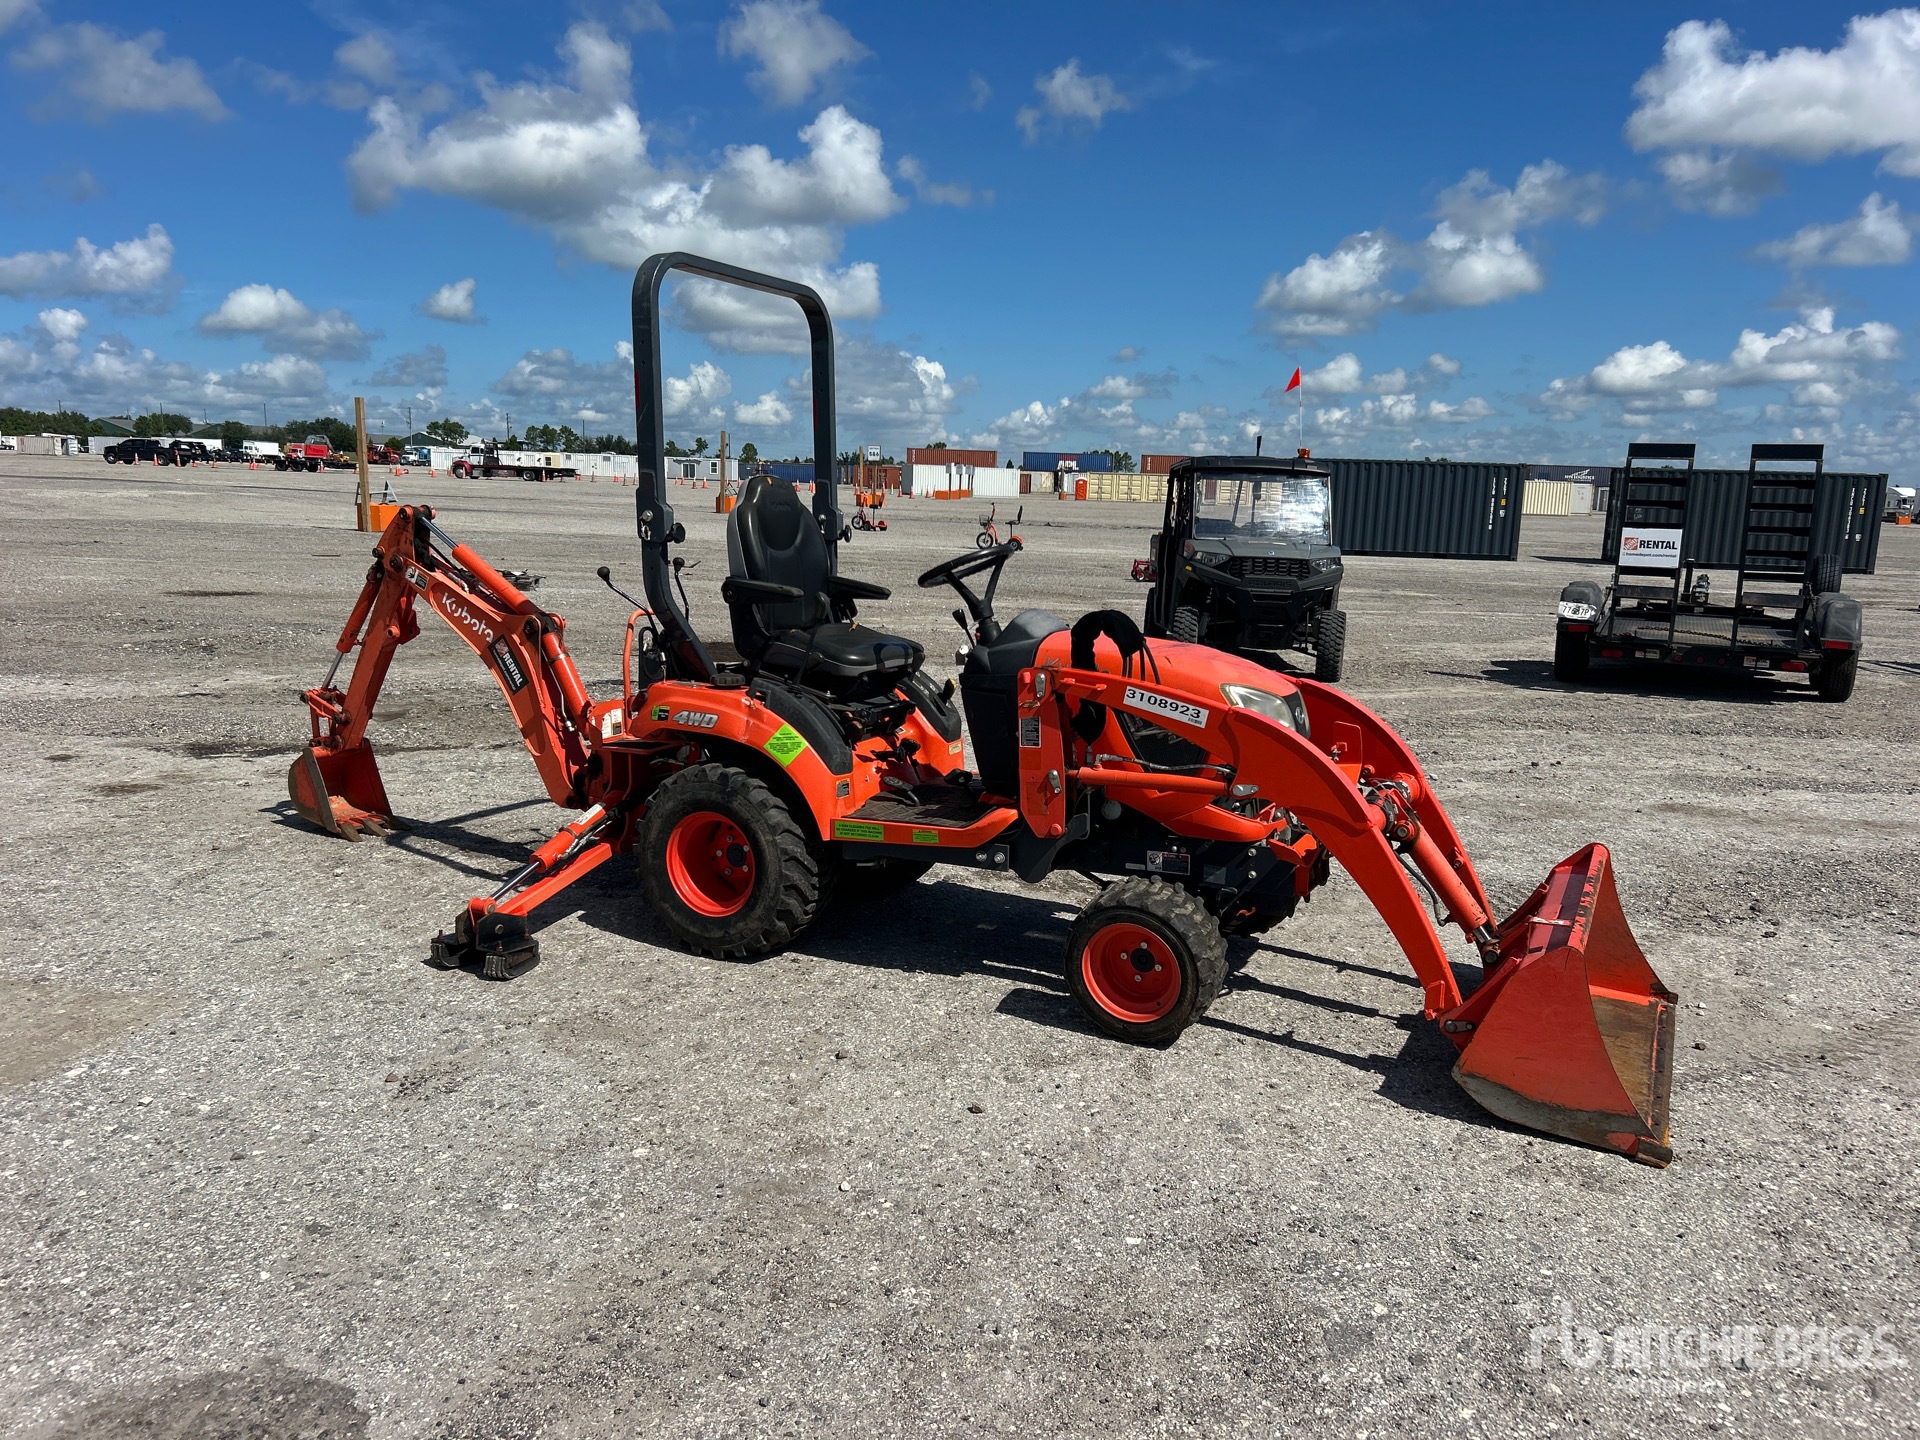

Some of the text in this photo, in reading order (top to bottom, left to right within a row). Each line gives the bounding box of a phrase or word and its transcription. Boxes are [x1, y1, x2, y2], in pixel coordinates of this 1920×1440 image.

[1639, 539, 1678, 550] RENTAL
[441, 592, 494, 643] Kubota
[502, 652, 524, 687] RENTAL
[672, 710, 719, 728] 4WD
[1125, 688, 1202, 720] 3108923
